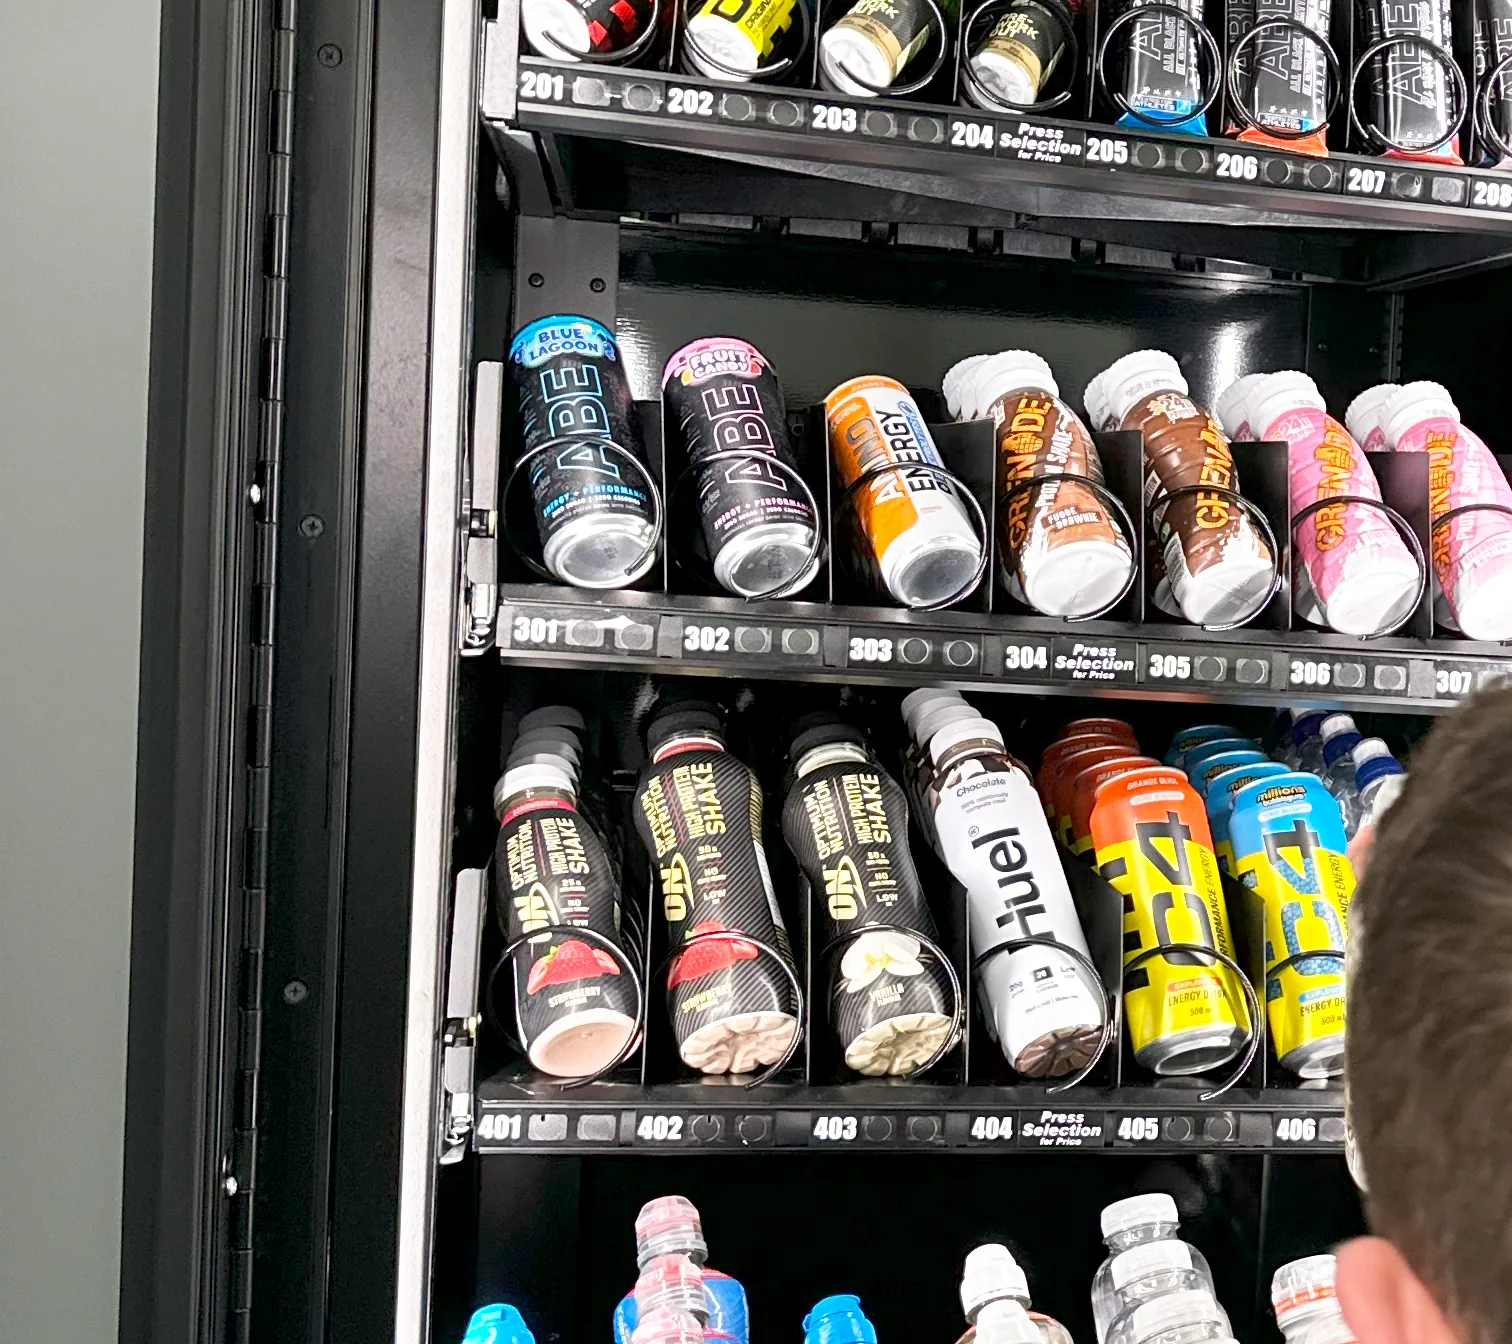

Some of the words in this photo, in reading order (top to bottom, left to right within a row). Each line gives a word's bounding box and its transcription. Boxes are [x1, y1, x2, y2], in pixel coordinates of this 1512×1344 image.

[520, 71, 564, 100] 201
[667, 87, 714, 115] 202
[812, 105, 857, 132] 203
[951, 122, 994, 148] 204
[1018, 123, 1064, 140] Press
[999, 133, 1081, 156] Selection
[1086, 138, 1128, 164] 205
[1216, 153, 1258, 180] 206
[1348, 167, 1386, 193] 207
[1474, 181, 1512, 206] 208
[538, 327, 583, 343] BLUE
[529, 339, 599, 359] LAGOON
[691, 349, 750, 365] FRUIT
[692, 360, 749, 376] CANDY
[880, 409, 937, 493] ENERGY
[513, 616, 558, 643] 301
[684, 626, 730, 652] 302
[850, 637, 893, 662] 303
[1006, 645, 1048, 670] 304
[1072, 643, 1117, 658] Press
[1054, 655, 1135, 672] Selection
[1149, 654, 1192, 679] 305
[1291, 661, 1331, 685] 306
[1435, 669, 1472, 694] 307
[691, 762, 727, 835] SHAKE
[955, 777, 1007, 797] Chocolate
[813, 779, 845, 854] NUTRITION
[859, 773, 892, 844] SHAKE
[803, 792, 831, 860] OPTIMUM
[1199, 847, 1215, 889] ENERGY
[969, 827, 1057, 956] huel
[1136, 811, 1216, 967] C4
[478, 1113, 522, 1141] 401
[637, 1114, 684, 1141] 402
[814, 1116, 857, 1141] 403
[971, 1116, 1013, 1141] 404
[1040, 1110, 1085, 1126] Press
[1117, 1117, 1159, 1141] 405
[1276, 1117, 1317, 1140] 406
[1022, 1123, 1102, 1139] Selection
